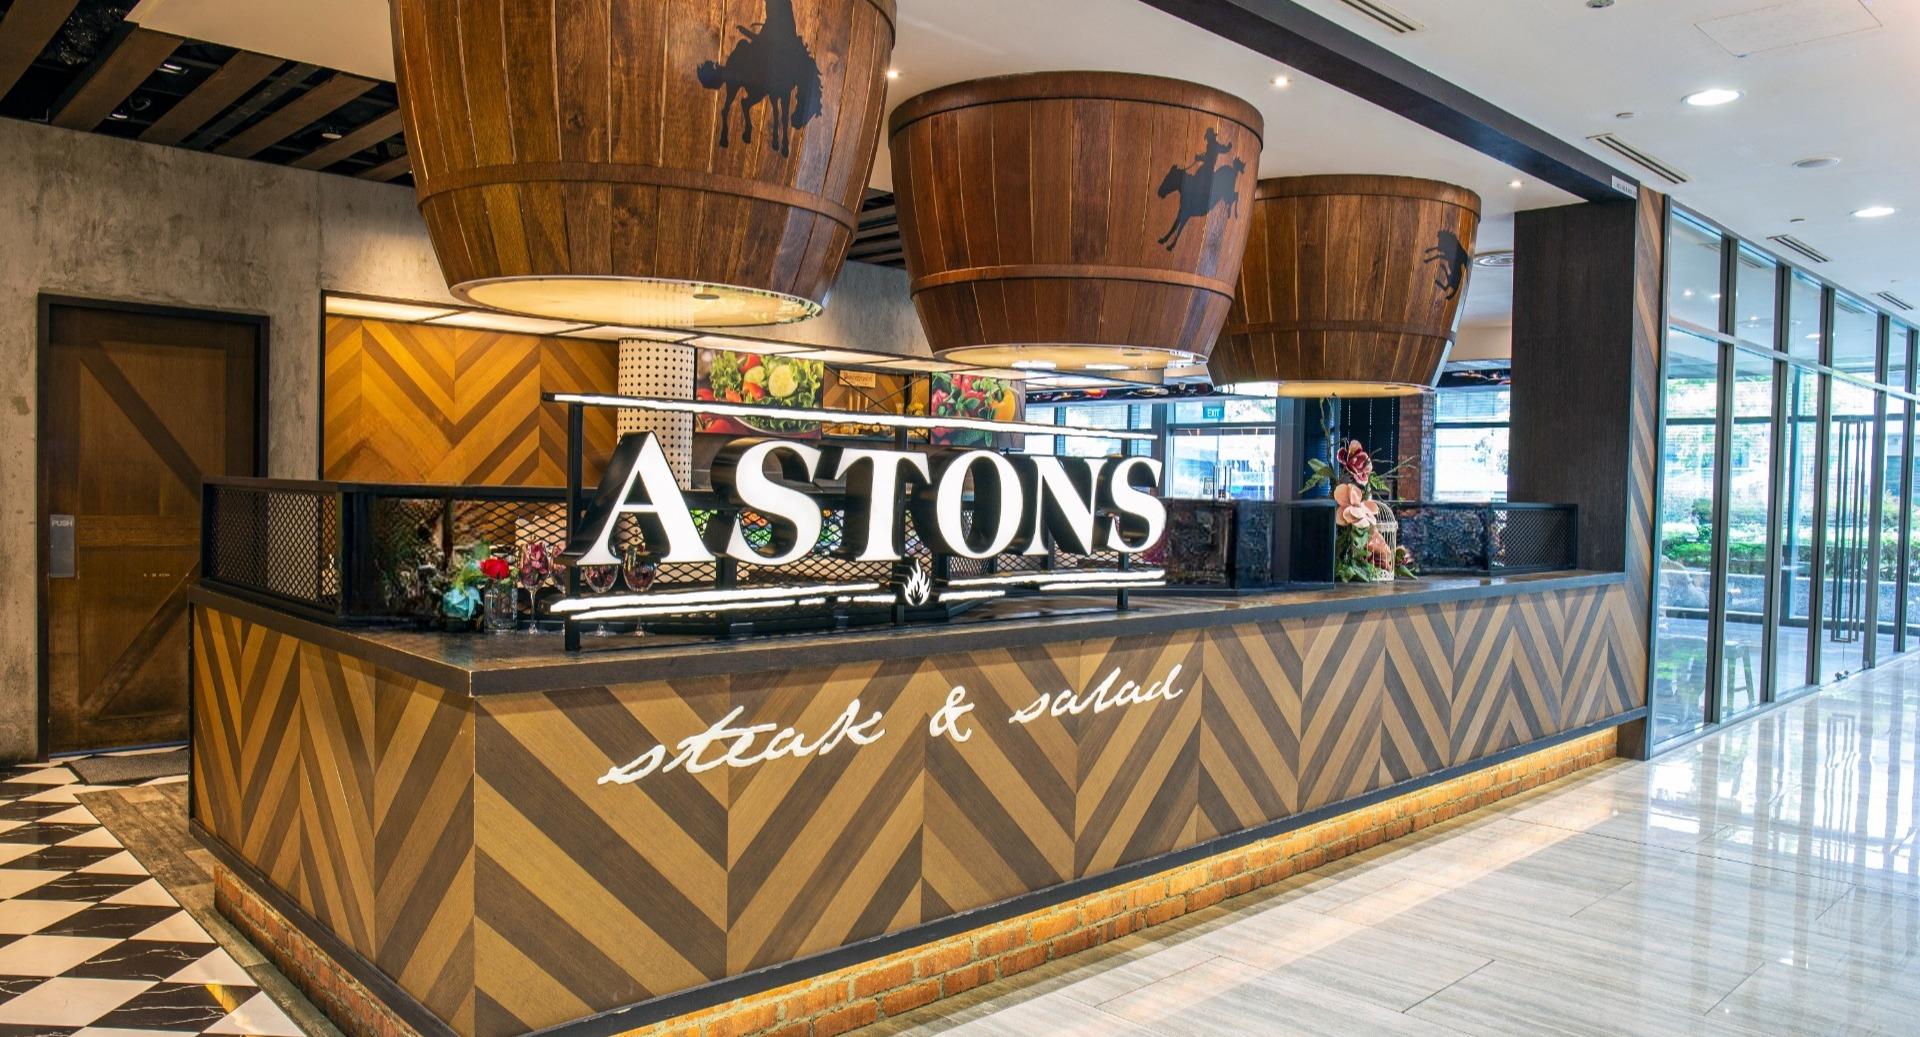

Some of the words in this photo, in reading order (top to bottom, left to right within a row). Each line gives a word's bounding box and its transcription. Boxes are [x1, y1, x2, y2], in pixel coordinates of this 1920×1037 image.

[1207, 408, 1220, 417] EXIT
[51, 519, 73, 527] PUSH
[575, 431, 1167, 566] ASTONS
[597, 699, 886, 785] steak
[928, 685, 976, 743] &
[1008, 663, 1184, 724] salad
